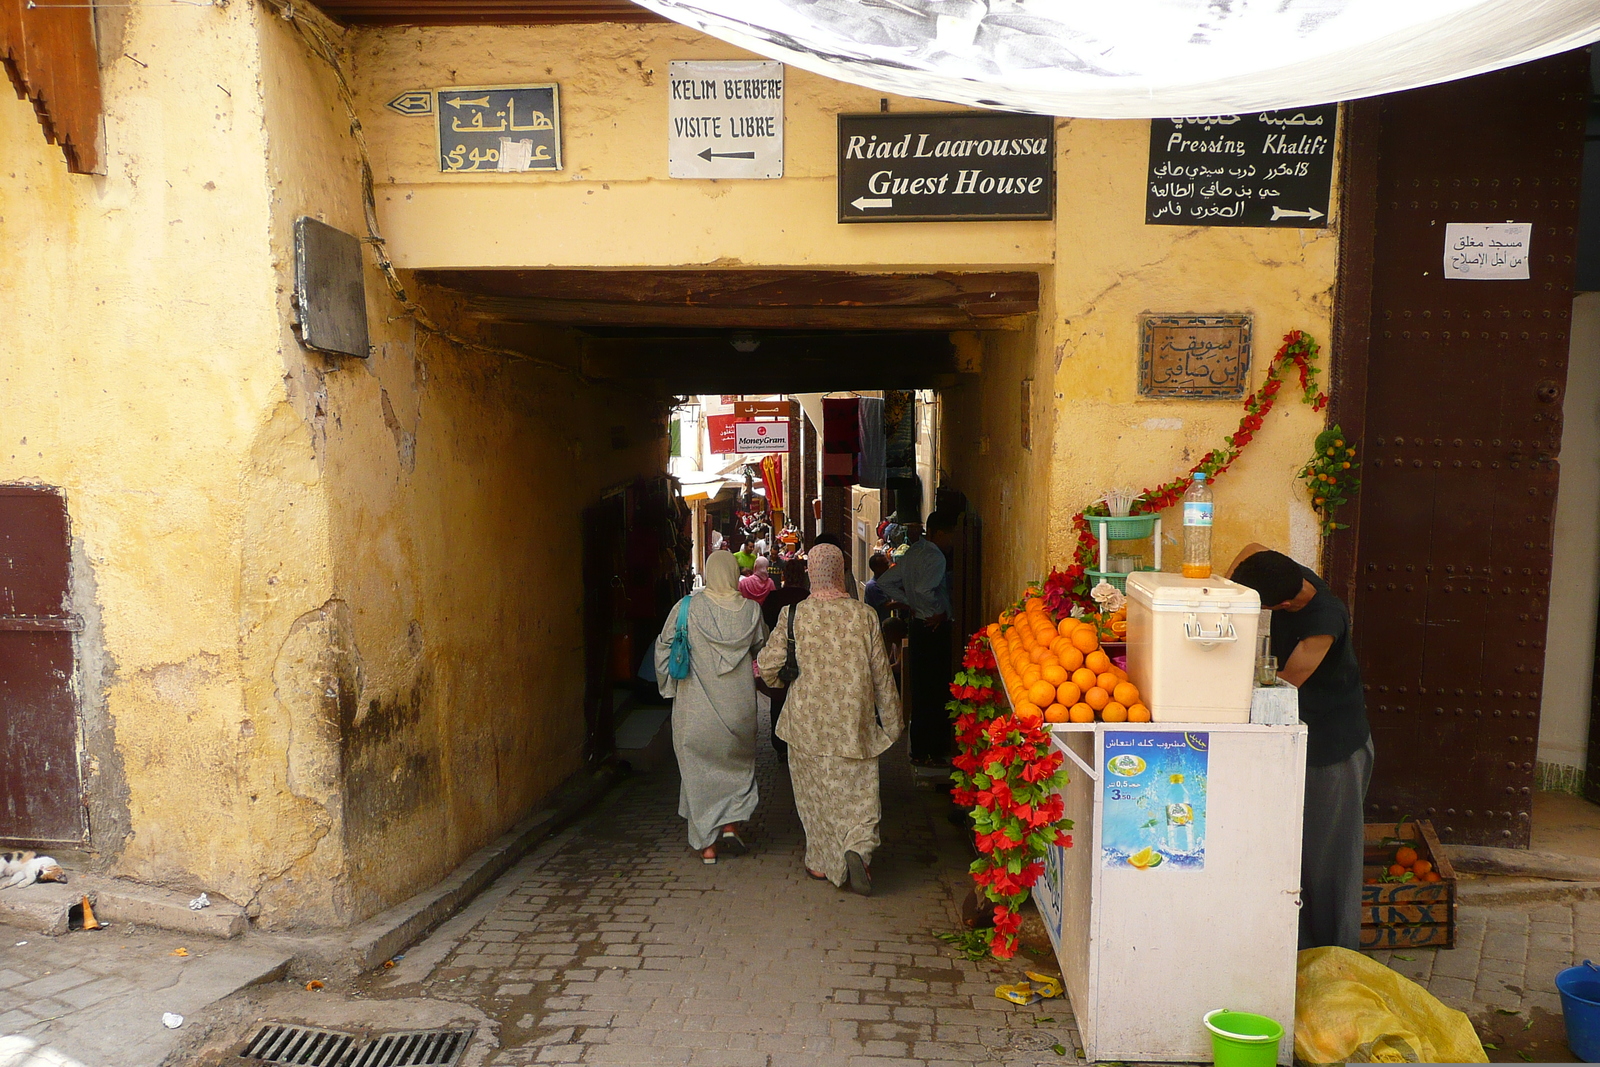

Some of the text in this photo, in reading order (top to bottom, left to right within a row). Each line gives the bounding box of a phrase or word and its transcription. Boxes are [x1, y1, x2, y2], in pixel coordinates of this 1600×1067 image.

[672, 79, 782, 100] KELIM BERBERE
[452, 97, 554, 132] هاتف
[675, 117, 775, 138] VISITE LIBRE
[846, 133, 1047, 159] Riad Laaroussa
[1167, 133, 1328, 157] Pressing Khalifi
[443, 144, 552, 172] عمومي
[1153, 160, 1185, 179] صافي
[1186, 165, 1225, 180] سيدي
[1228, 164, 1256, 180] درب
[868, 169, 1043, 195] Guest House
[1150, 180, 1281, 199] حي بن صافي الطالعة
[1152, 200, 1182, 218] فاس
[1453, 235, 1523, 251] مسجد مغلق
[1452, 250, 1522, 269] من أجل الإصلاح
[744, 404, 779, 414] صرف
[739, 437, 785, 446] MoneyGram
